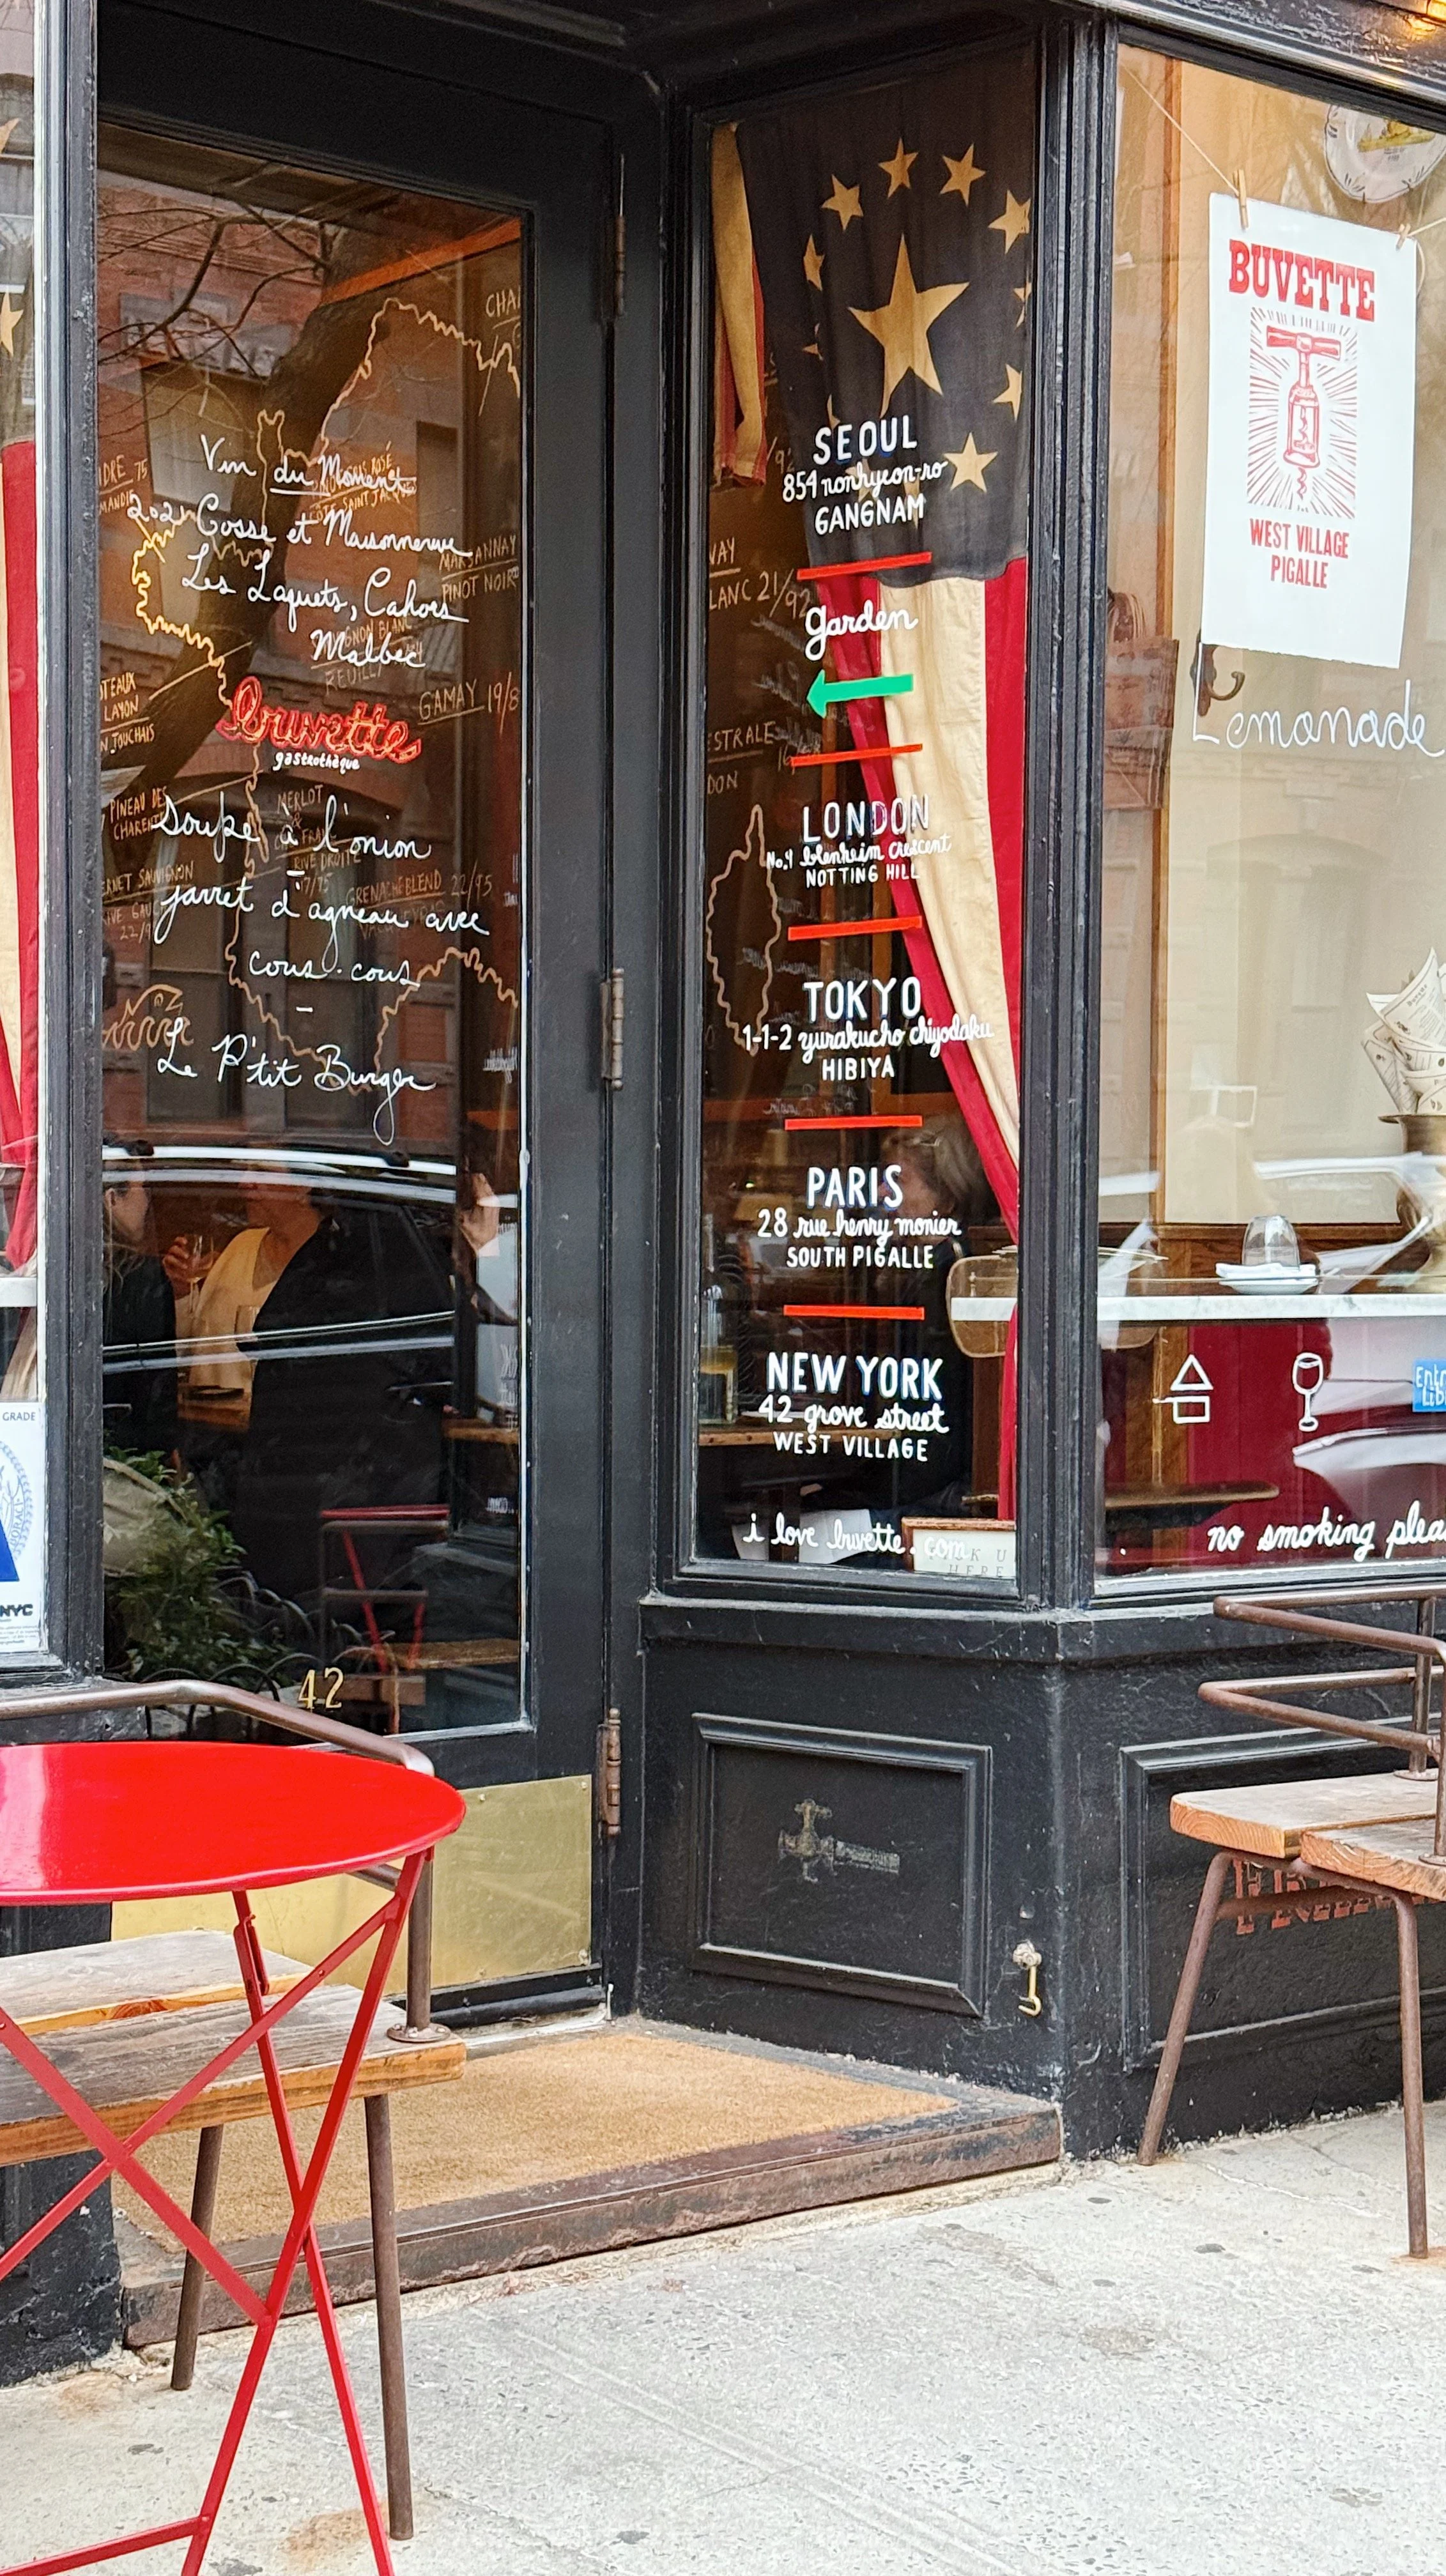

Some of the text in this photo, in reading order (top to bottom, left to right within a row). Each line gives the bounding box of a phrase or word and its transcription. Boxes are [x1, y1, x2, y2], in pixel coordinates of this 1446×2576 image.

[1228, 238, 1375, 323] BUVETTE
[813, 415, 918, 465] SEOUL
[134, 458, 148, 481] 75
[201, 434, 417, 494] Vin du Moment
[782, 461, 948, 503] 854 nonhyeon-ro
[287, 512, 319, 544] et
[815, 494, 925, 535] GANGNAM
[1249, 518, 1349, 559] WEST VILLAGE
[181, 543, 236, 594] Les
[441, 575, 480, 603] PINOT
[1270, 554, 1329, 589] PIGALLE
[310, 629, 426, 668] Malbec
[804, 600, 919, 662] garden
[104, 694, 139, 721] LAYON
[419, 678, 477, 721] GAMAY
[1192, 641, 1446, 757] Lemonade
[111, 723, 155, 750] TOUCHAIS
[215, 676, 422, 764] buvette
[272, 752, 360, 775] gastrothèque
[110, 792, 145, 824] PINEAU
[277, 785, 323, 815] MERLOT
[803, 794, 930, 844] LONDON
[151, 790, 432, 862] Soupe à l'onion
[799, 842, 884, 866] blenheim
[888, 835, 951, 859] crescent
[806, 863, 921, 889] NOTTING HILL
[153, 877, 254, 944] jarret
[424, 910, 490, 935] avec
[803, 977, 921, 1023] TOKYO
[742, 1016, 994, 1064] 1-1-2 yurakucho chiyodaku
[157, 1017, 198, 1077] Le
[314, 1044, 436, 1146] Burger
[822, 1057, 895, 1082] HIBIYA
[806, 1165, 904, 1209] PARIS
[757, 1209, 962, 1247] 28 rue henry monier
[786, 1245, 934, 1270] SOUTH PIGALLE
[768, 1352, 944, 1402] NEW YORK
[1422, 1385, 1446, 1407] Lib
[3, 1411, 36, 1422] GRADE
[758, 1395, 950, 1434] 42 grove street
[773, 1432, 928, 1462] WEST VILLAGE
[770, 1512, 819, 1548] love
[1207, 1525, 1245, 1552] no
[1256, 1506, 1376, 1561] smoking
[298, 1667, 344, 1710] 42
